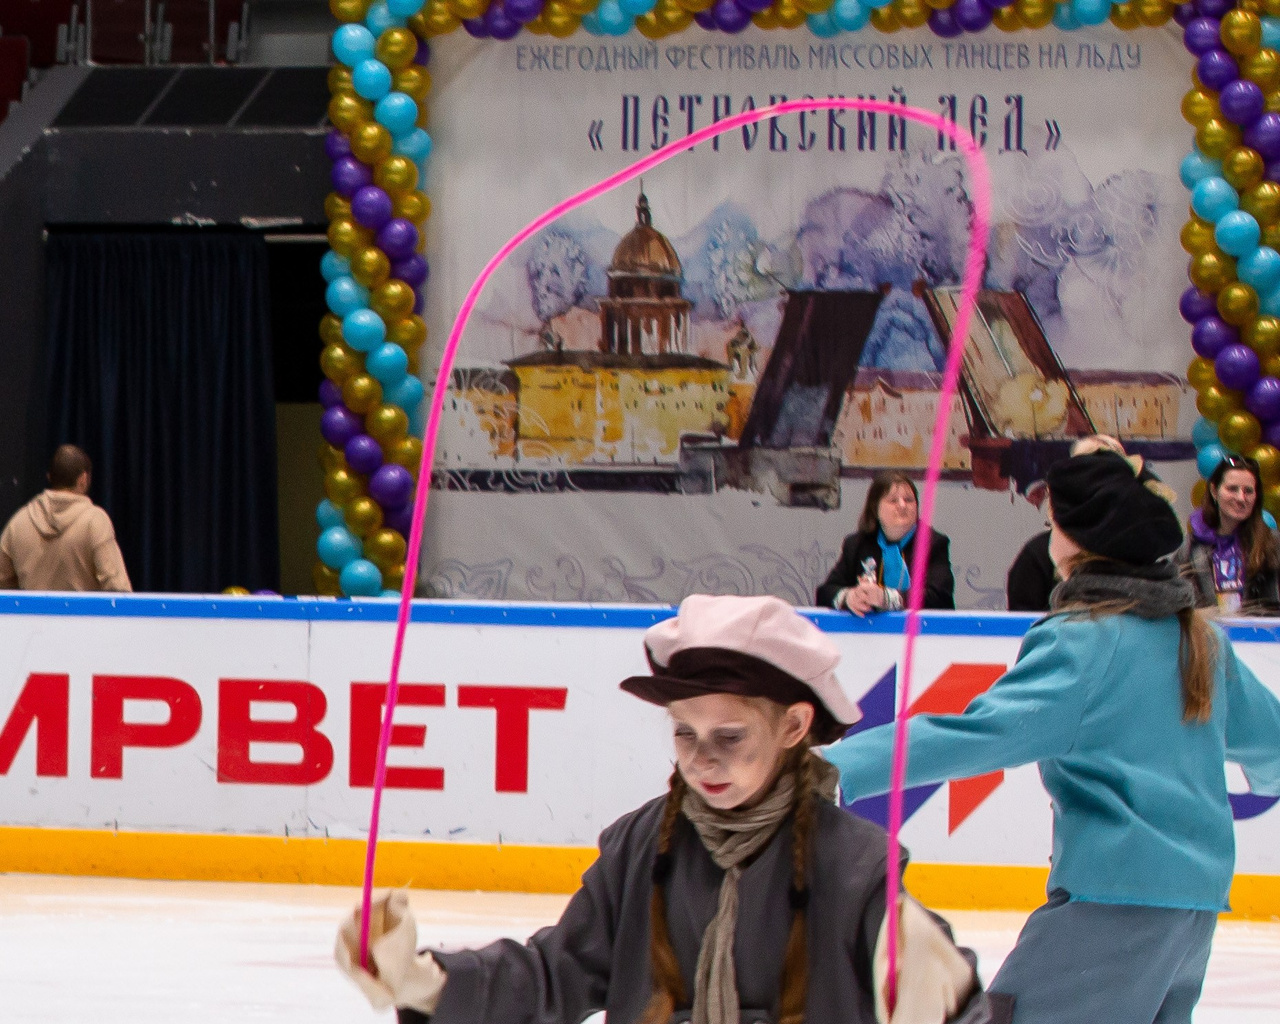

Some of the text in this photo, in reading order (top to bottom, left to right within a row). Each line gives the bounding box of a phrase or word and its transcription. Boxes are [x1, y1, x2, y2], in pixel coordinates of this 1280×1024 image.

[516, 41, 1142, 72] ЕЖЕГОДНЫЙ ФЕСТИВАЛЬ МАССОВЫХ ТАНЦЕВ НА ЛЬДУ
